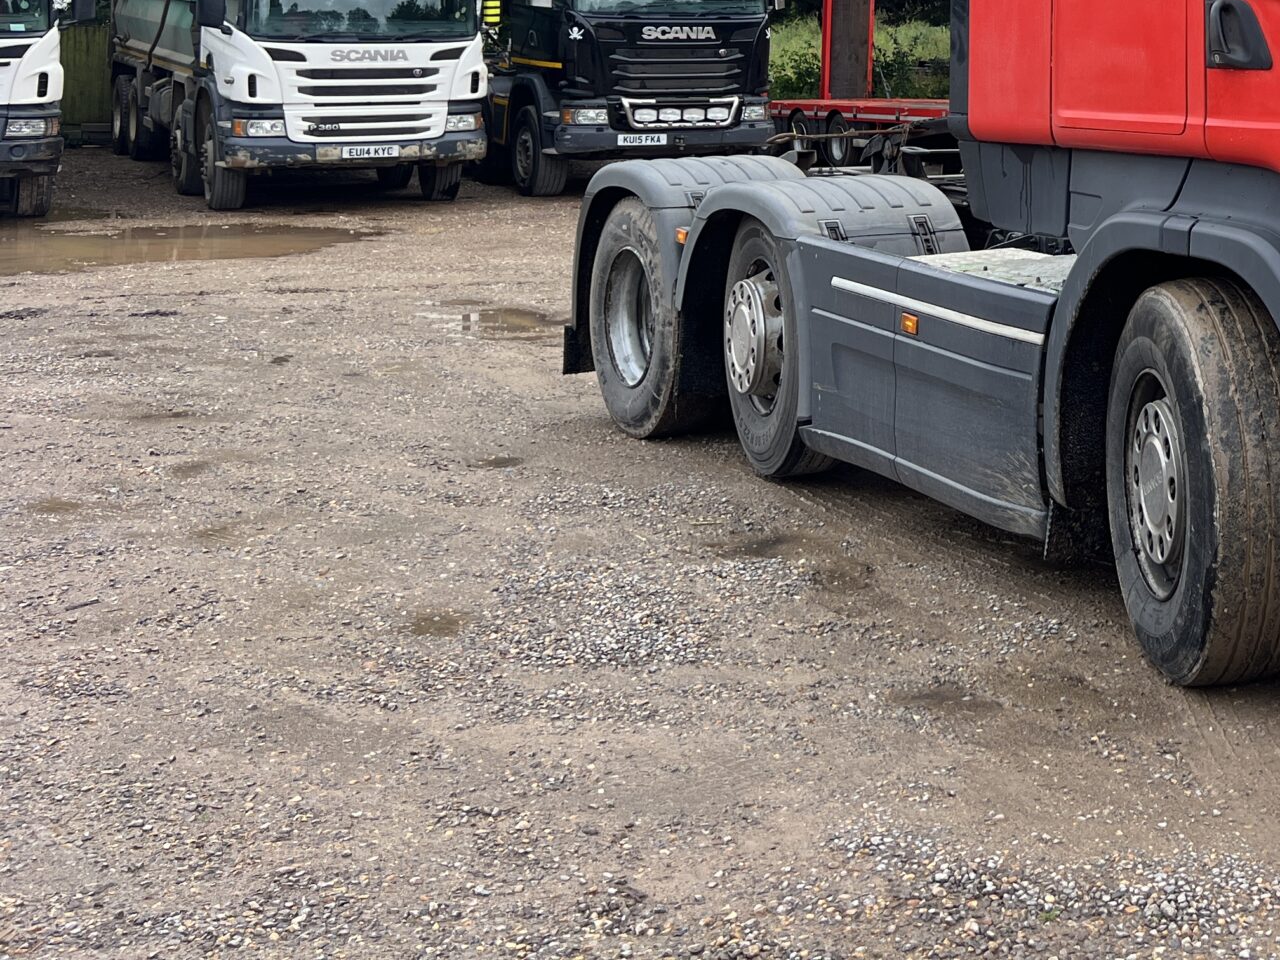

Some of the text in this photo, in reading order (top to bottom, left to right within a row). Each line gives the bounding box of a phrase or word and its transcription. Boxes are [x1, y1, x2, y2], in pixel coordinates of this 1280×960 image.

[641, 26, 716, 39] SCANIA
[330, 50, 408, 61] SCANIA
[623, 135, 661, 144] KU15 FKA
[349, 147, 371, 156] EU14
